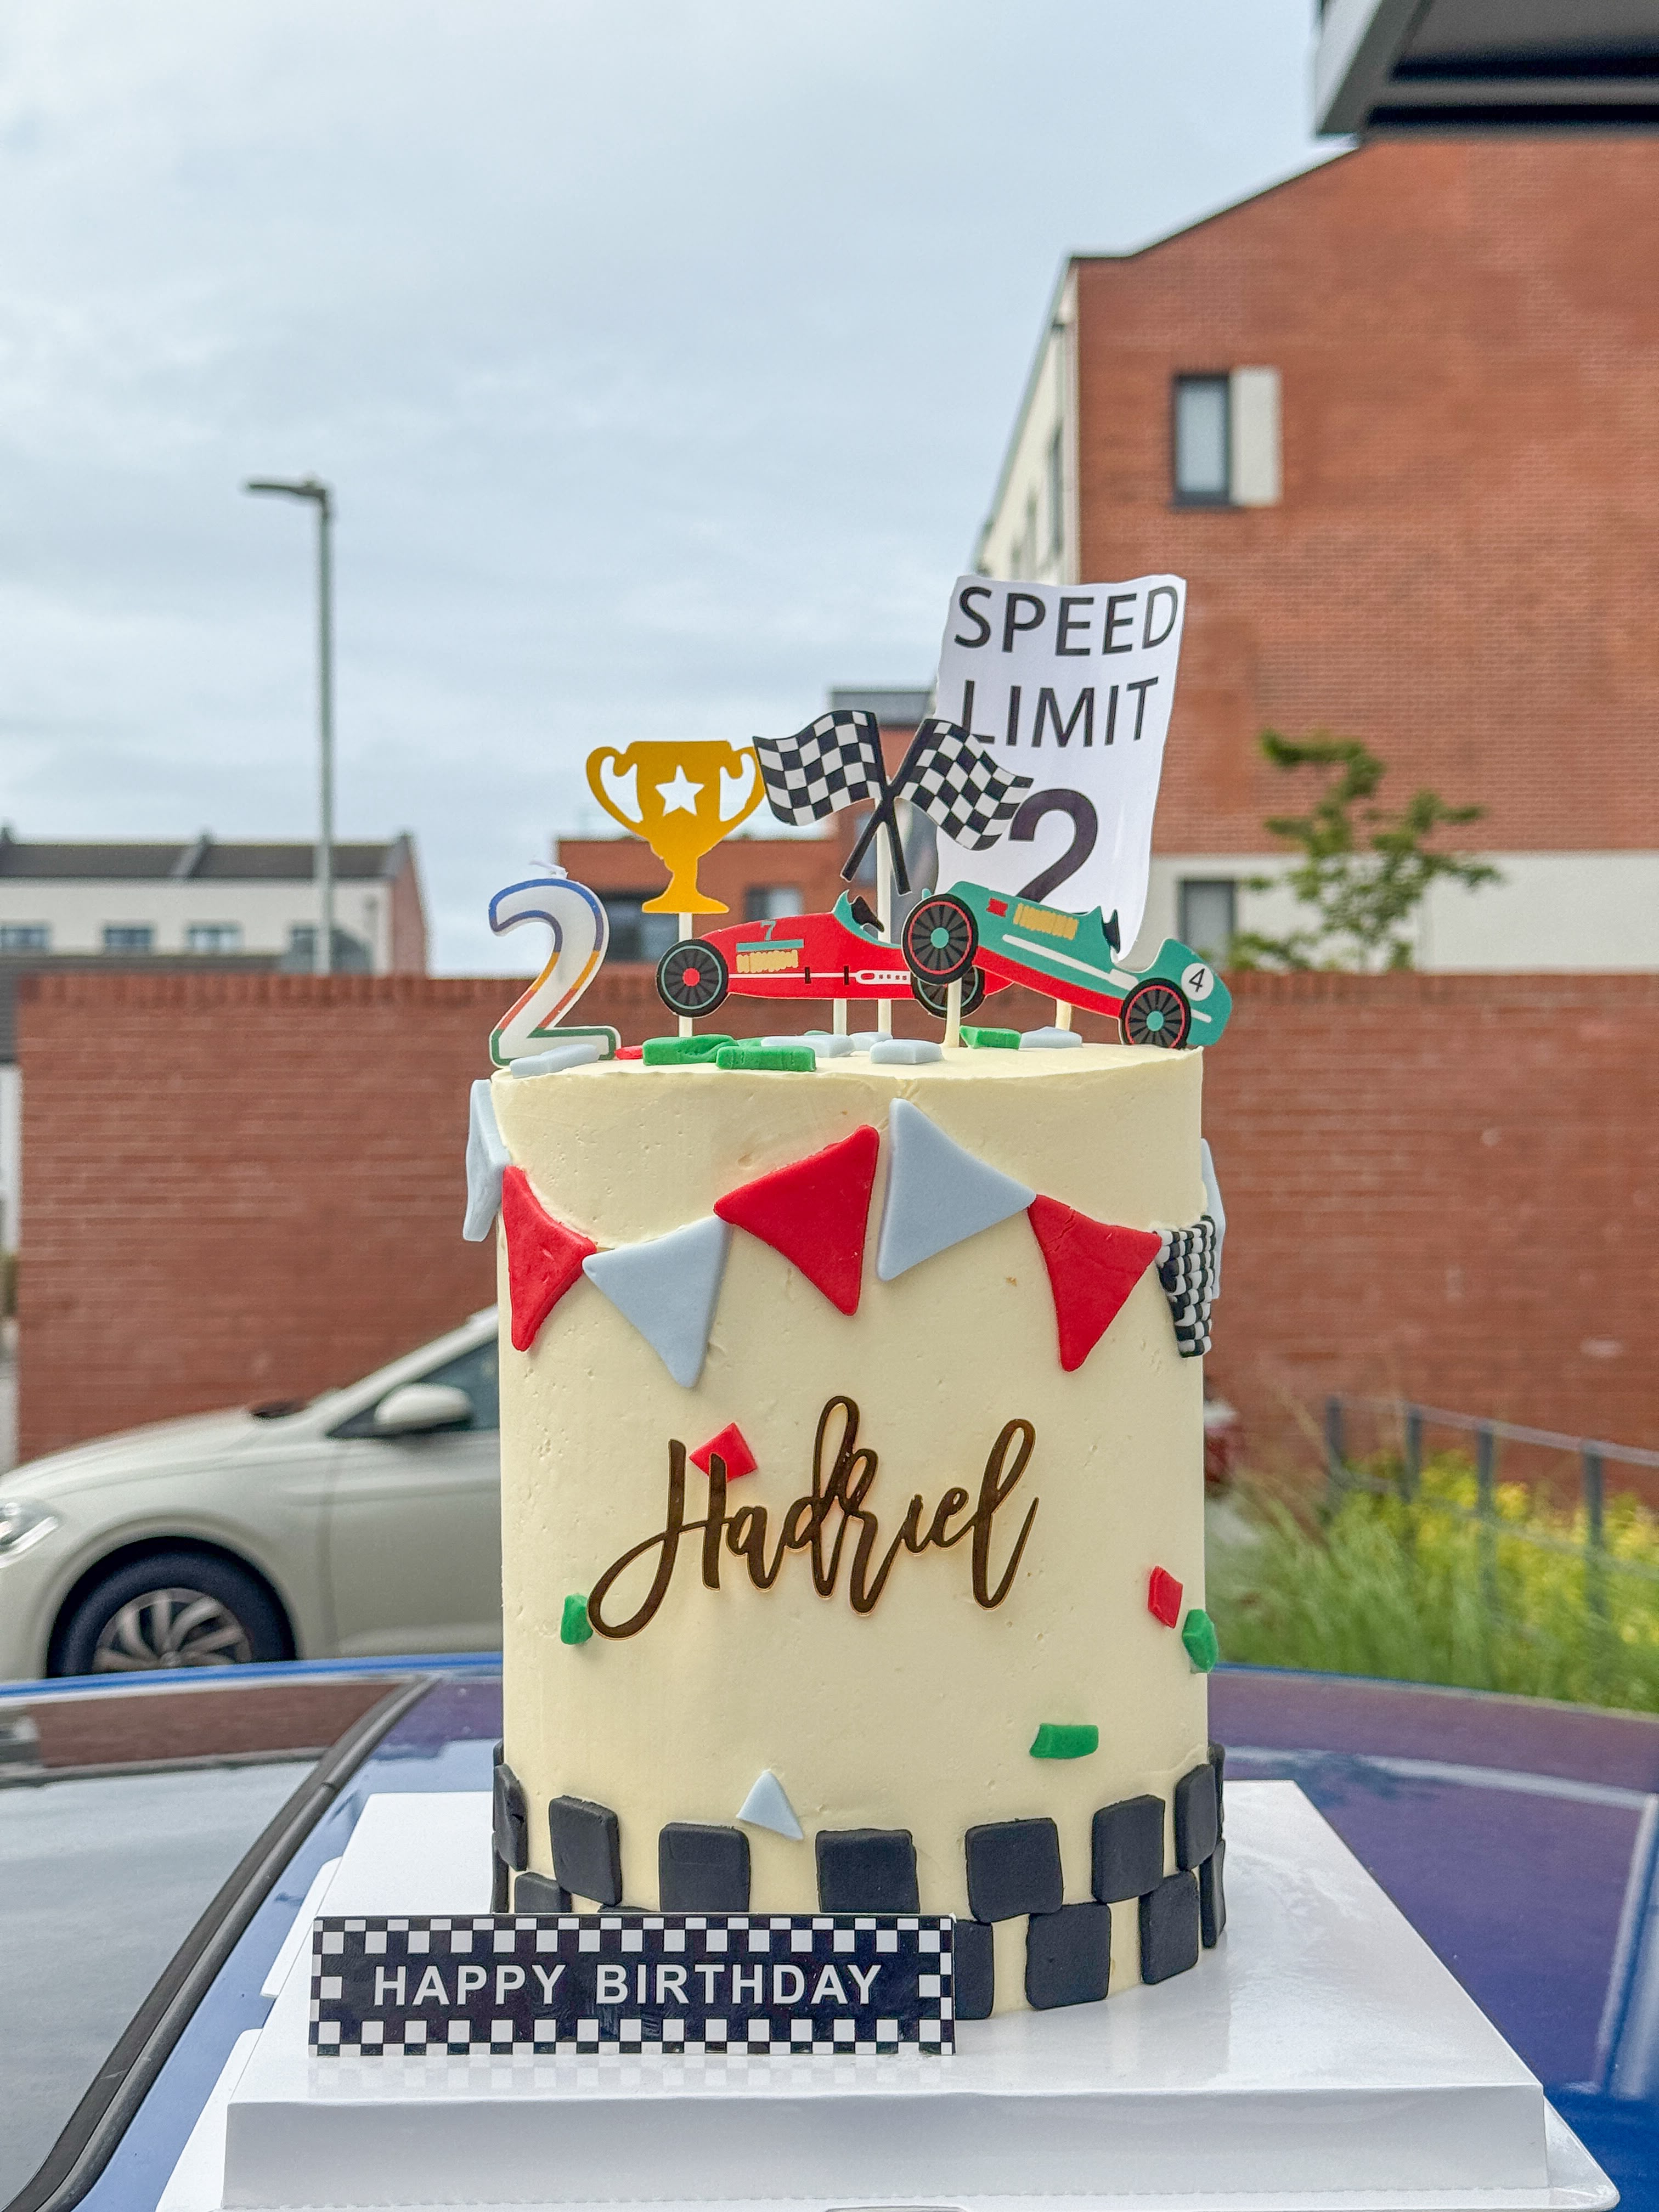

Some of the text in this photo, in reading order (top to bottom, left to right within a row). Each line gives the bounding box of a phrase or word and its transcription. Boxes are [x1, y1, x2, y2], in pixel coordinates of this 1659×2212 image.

[954, 585, 1178, 656] SPEED
[961, 676, 1159, 748] LIMIT
[1008, 788, 1098, 903] 2
[760, 921, 777, 941] 7
[1188, 968, 1205, 992] 4
[374, 1964, 882, 2006] HAPPY BIRTHDAY
